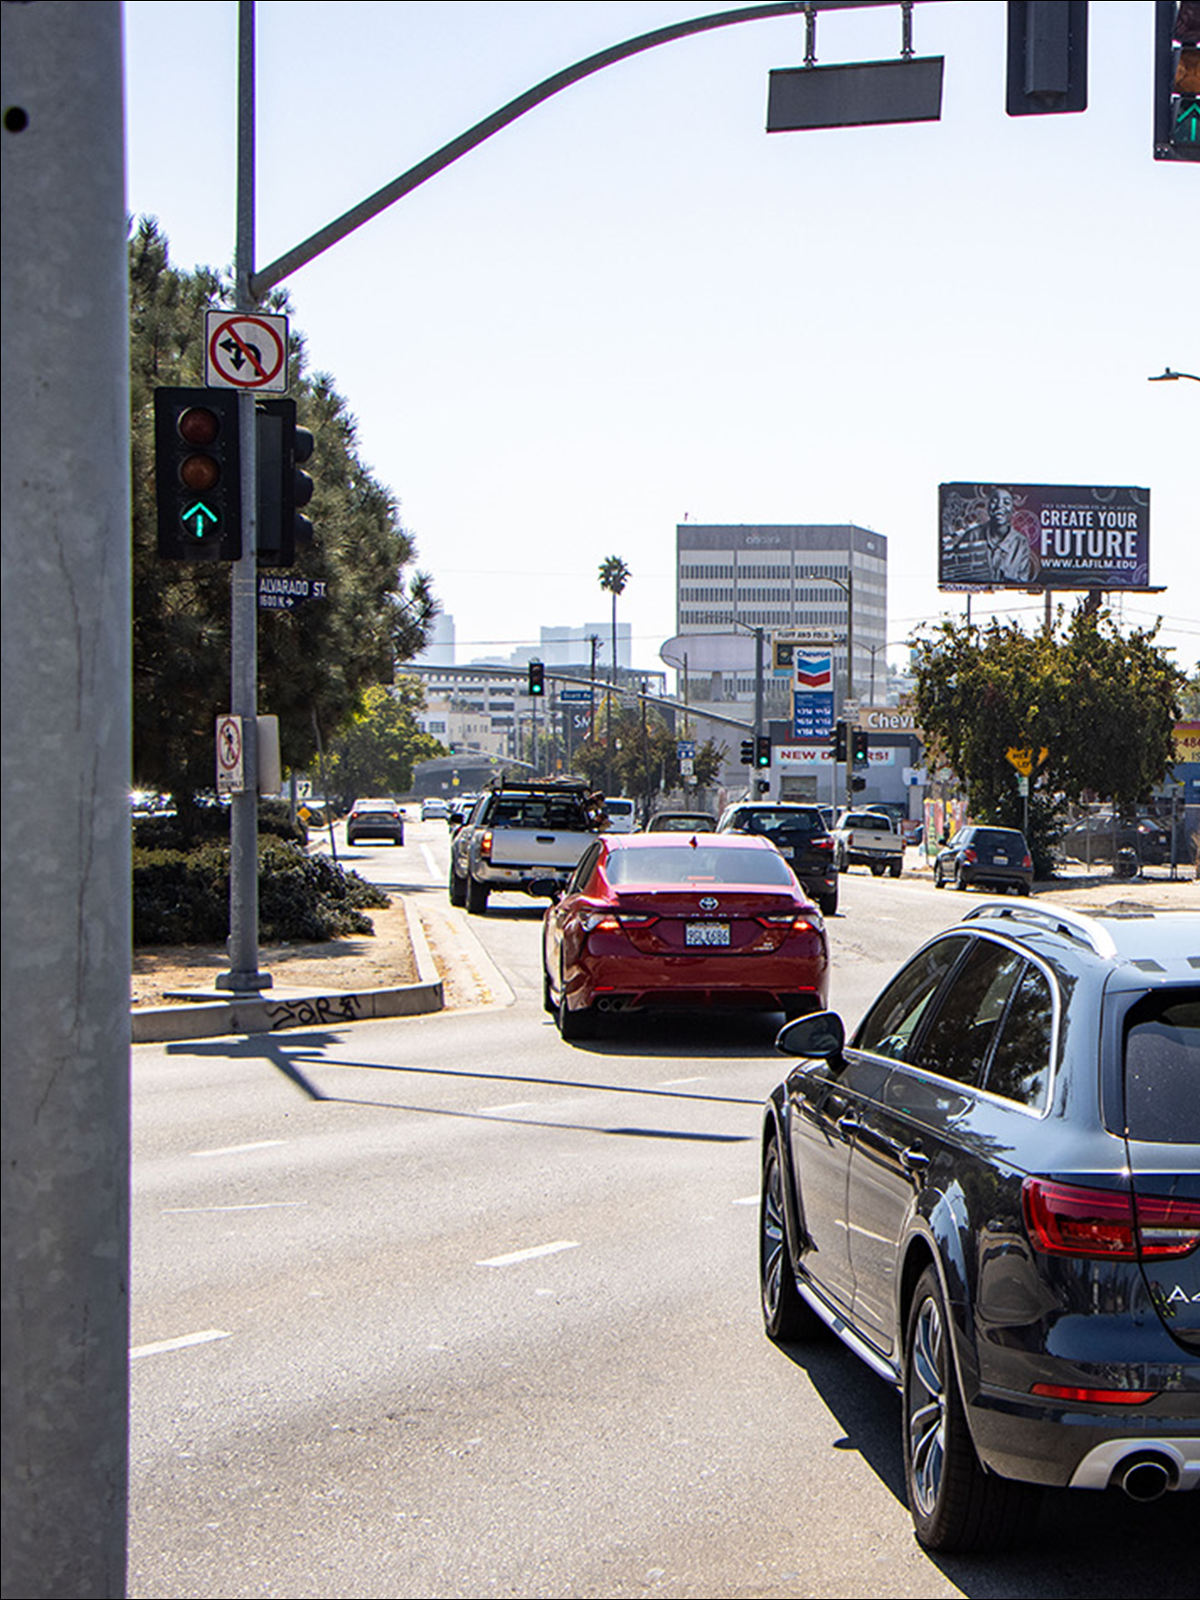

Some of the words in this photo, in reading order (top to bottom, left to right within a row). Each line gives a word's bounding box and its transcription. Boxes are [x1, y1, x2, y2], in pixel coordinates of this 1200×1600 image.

[1040, 510, 1093, 528] CREATE
[1098, 511, 1137, 529] YOUR
[1041, 529, 1137, 558] FUTURE
[1041, 558, 1138, 570] WWW.LAFILM.EDU
[259, 579, 309, 596] ALVARADO
[796, 650, 831, 658] Chevron
[780, 751, 817, 760] NEW
